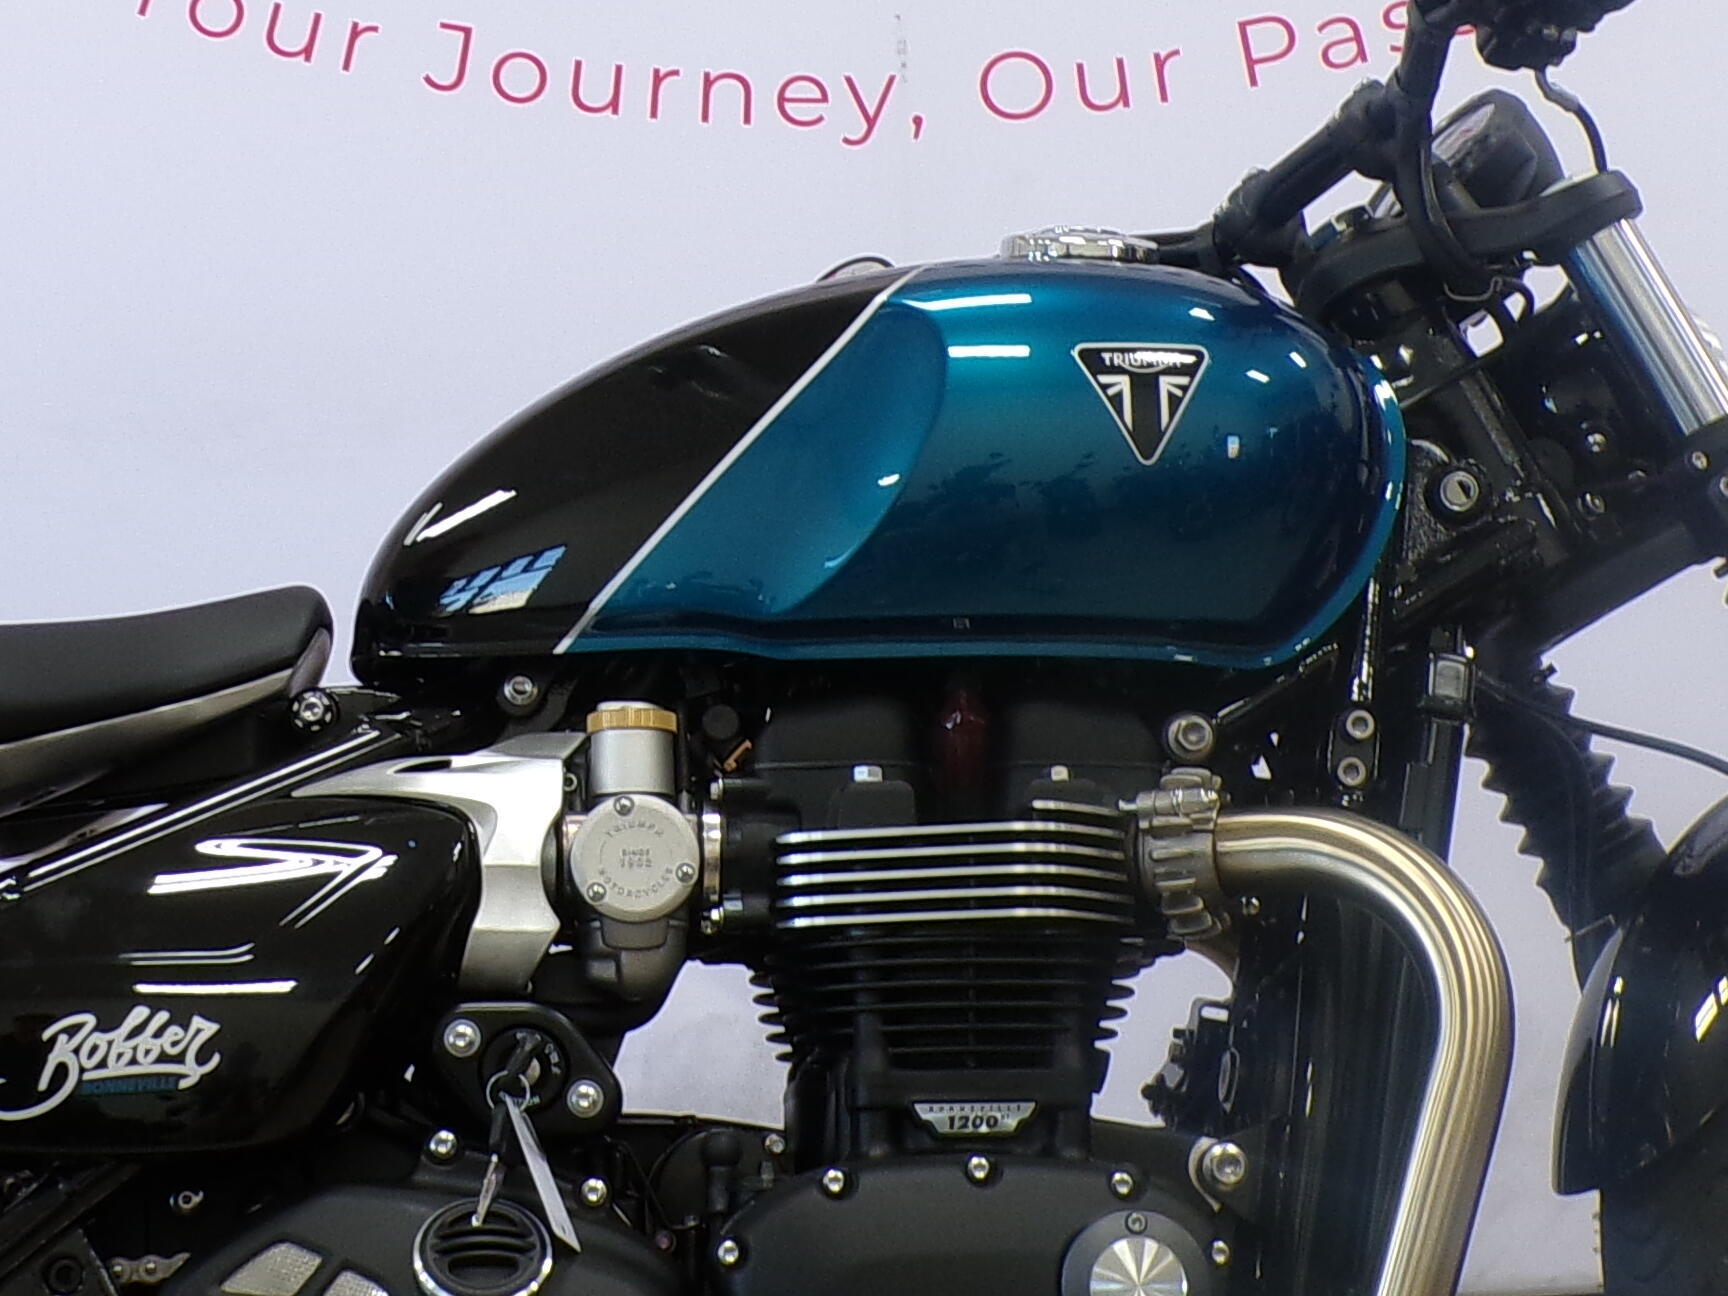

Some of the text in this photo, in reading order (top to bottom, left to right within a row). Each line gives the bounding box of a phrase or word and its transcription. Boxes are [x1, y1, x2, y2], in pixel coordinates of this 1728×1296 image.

[422, 20, 925, 147] Journey,
[979, 48, 1182, 121] Our
[948, 1115, 1000, 1130] 1200
